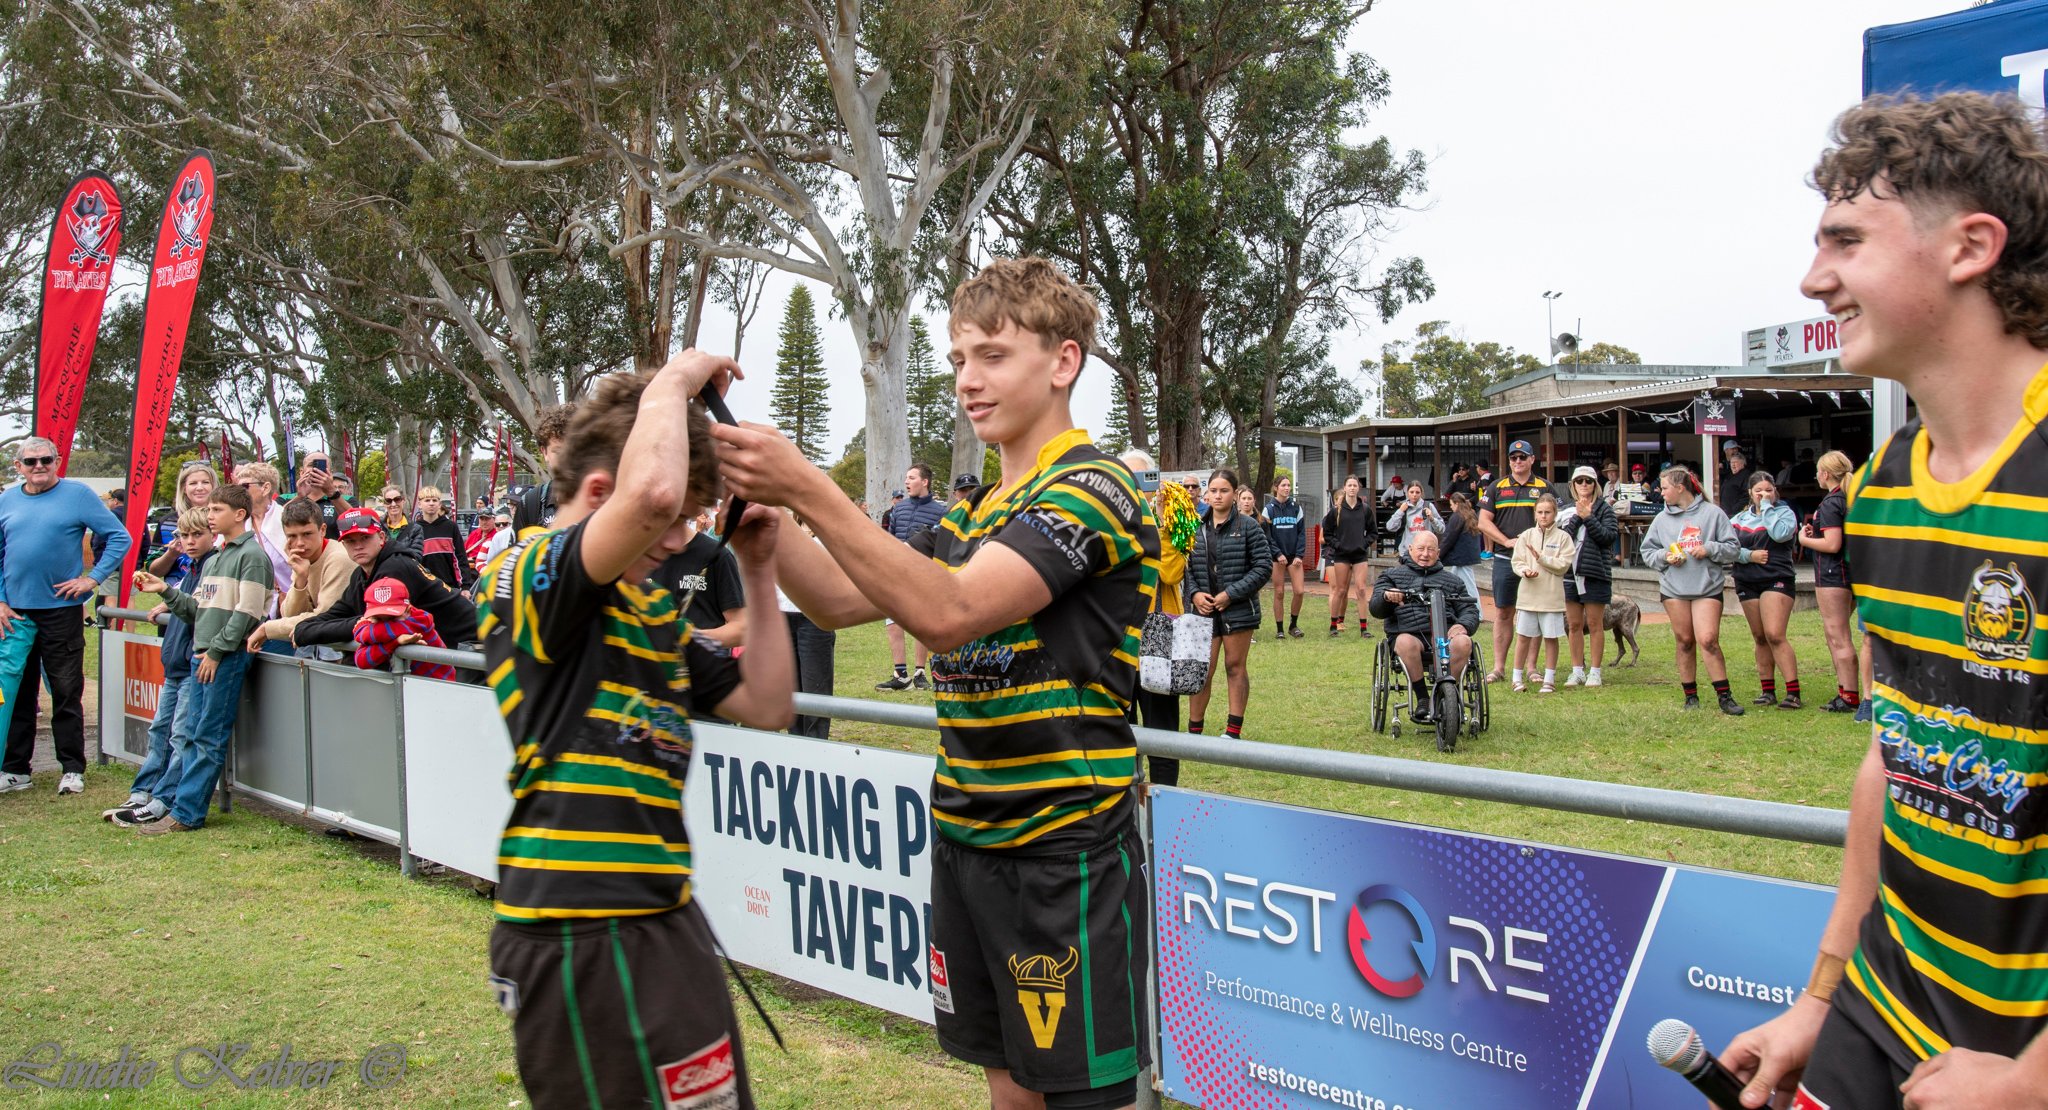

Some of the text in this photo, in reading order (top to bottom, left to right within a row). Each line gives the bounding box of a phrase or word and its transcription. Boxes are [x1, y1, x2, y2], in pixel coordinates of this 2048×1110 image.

[52, 270, 107, 292] PIRATES
[156, 258, 199, 288] PIRATES
[1803, 319, 1838, 354] POR
[51, 322, 82, 423] MACQUARIE
[60, 383, 77, 421] UNION
[72, 344, 86, 376] CLUB
[156, 387, 169, 431] UNION
[166, 342, 178, 379] CLUB
[131, 321, 174, 497] PORT MACQUARIE
[1015, 512, 1084, 571] ANCIAL GROUP
[2004, 669, 2031, 685] 14s
[703, 752, 938, 878] TACKING P
[744, 884, 771, 904] OCEAN
[746, 900, 769, 919] DRIVE
[1687, 965, 1795, 1007] Contrast
[1018, 989, 1066, 1049] V
[1204, 969, 1528, 1073] Performance & Wellness Centre
[1248, 1060, 1417, 1110] restorecentre
